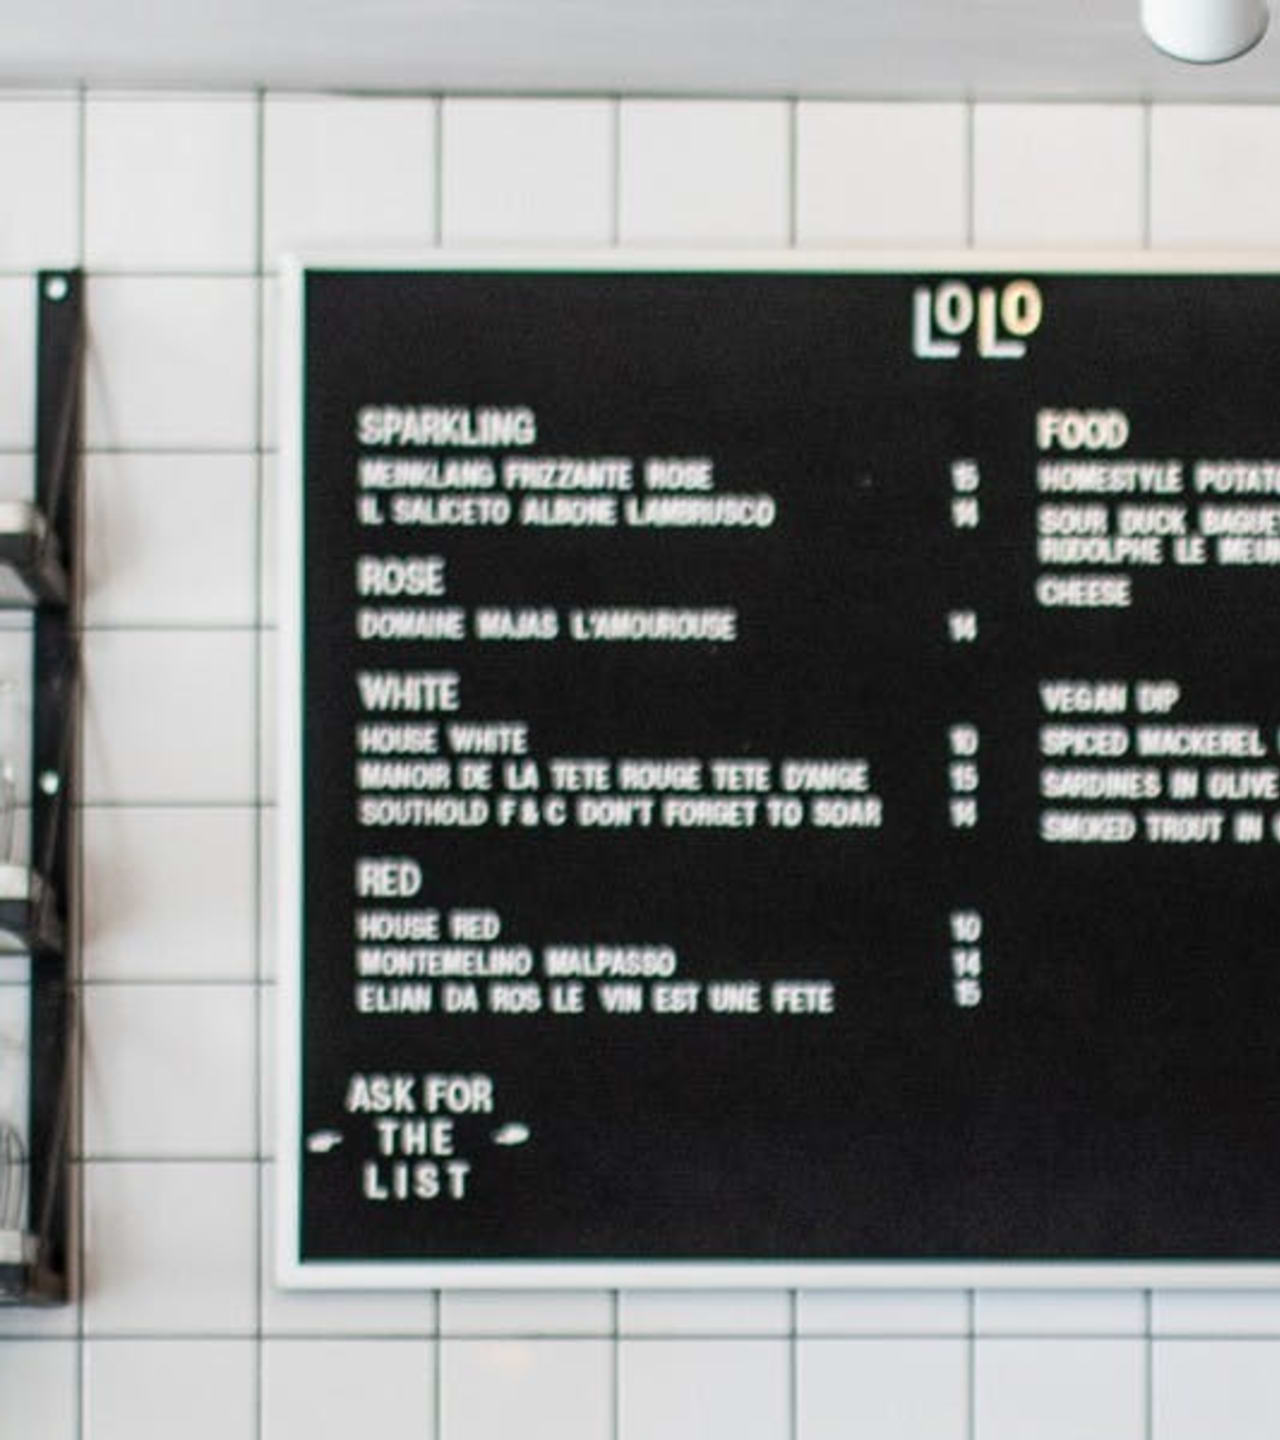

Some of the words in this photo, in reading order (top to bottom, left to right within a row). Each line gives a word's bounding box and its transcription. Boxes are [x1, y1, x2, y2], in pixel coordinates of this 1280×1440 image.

[358, 406, 536, 446] SPARKLING
[1036, 409, 1129, 450] FOOD
[502, 458, 633, 491] FRIZZANTE
[644, 458, 713, 491] ROSE
[1037, 460, 1183, 494] HOMESTYLE
[391, 494, 511, 527] SALICETO
[624, 494, 776, 527] LAMBRUSCO
[1037, 504, 1109, 536] SOUR
[1117, 504, 1188, 536] DUCK
[1173, 535, 1207, 565] LE
[357, 556, 445, 596] ROSE
[1036, 575, 1131, 607] CHEESE
[357, 608, 465, 641] DOMAINE
[358, 672, 459, 711] WHITE
[1040, 682, 1127, 713] VEGAN
[1136, 682, 1180, 713] DIP
[357, 724, 438, 754] HOUSE
[448, 724, 527, 754] WHITE
[1040, 725, 1129, 757] SPICED
[1136, 725, 1266, 757] MACKEREL
[357, 759, 451, 792] MANOIR
[459, 759, 492, 792] DE
[504, 759, 539, 792] LA
[550, 759, 610, 792] TETE
[618, 759, 702, 792] ROUGE
[711, 759, 771, 792] TETE
[1041, 768, 1162, 800] SARDINES
[1169, 768, 1199, 800] IN
[1206, 768, 1279, 800] OLIVE
[359, 796, 489, 827] SOUTHOLD
[577, 796, 654, 827] DON'T
[662, 796, 758, 827] FORGET
[766, 796, 803, 827] TO
[812, 796, 882, 827] SOAR
[1041, 810, 1137, 843] SMOKED
[1145, 810, 1224, 843] TROUT
[1234, 810, 1264, 843] IN
[356, 859, 422, 897] RED
[356, 911, 439, 941] HOUSE
[449, 911, 501, 941] RED
[544, 946, 677, 977] MALPASSO
[356, 981, 432, 1013] ELIAN
[442, 981, 479, 1013] DA
[550, 981, 584, 1013] LE
[599, 981, 643, 1013] VIN
[651, 981, 700, 1013] EST
[707, 981, 761, 1013] UNE
[771, 981, 834, 1013] FETE
[347, 1074, 417, 1113] ASK
[424, 1074, 494, 1113] FOR
[375, 1118, 454, 1156] THE
[363, 1161, 471, 1200] LIST
